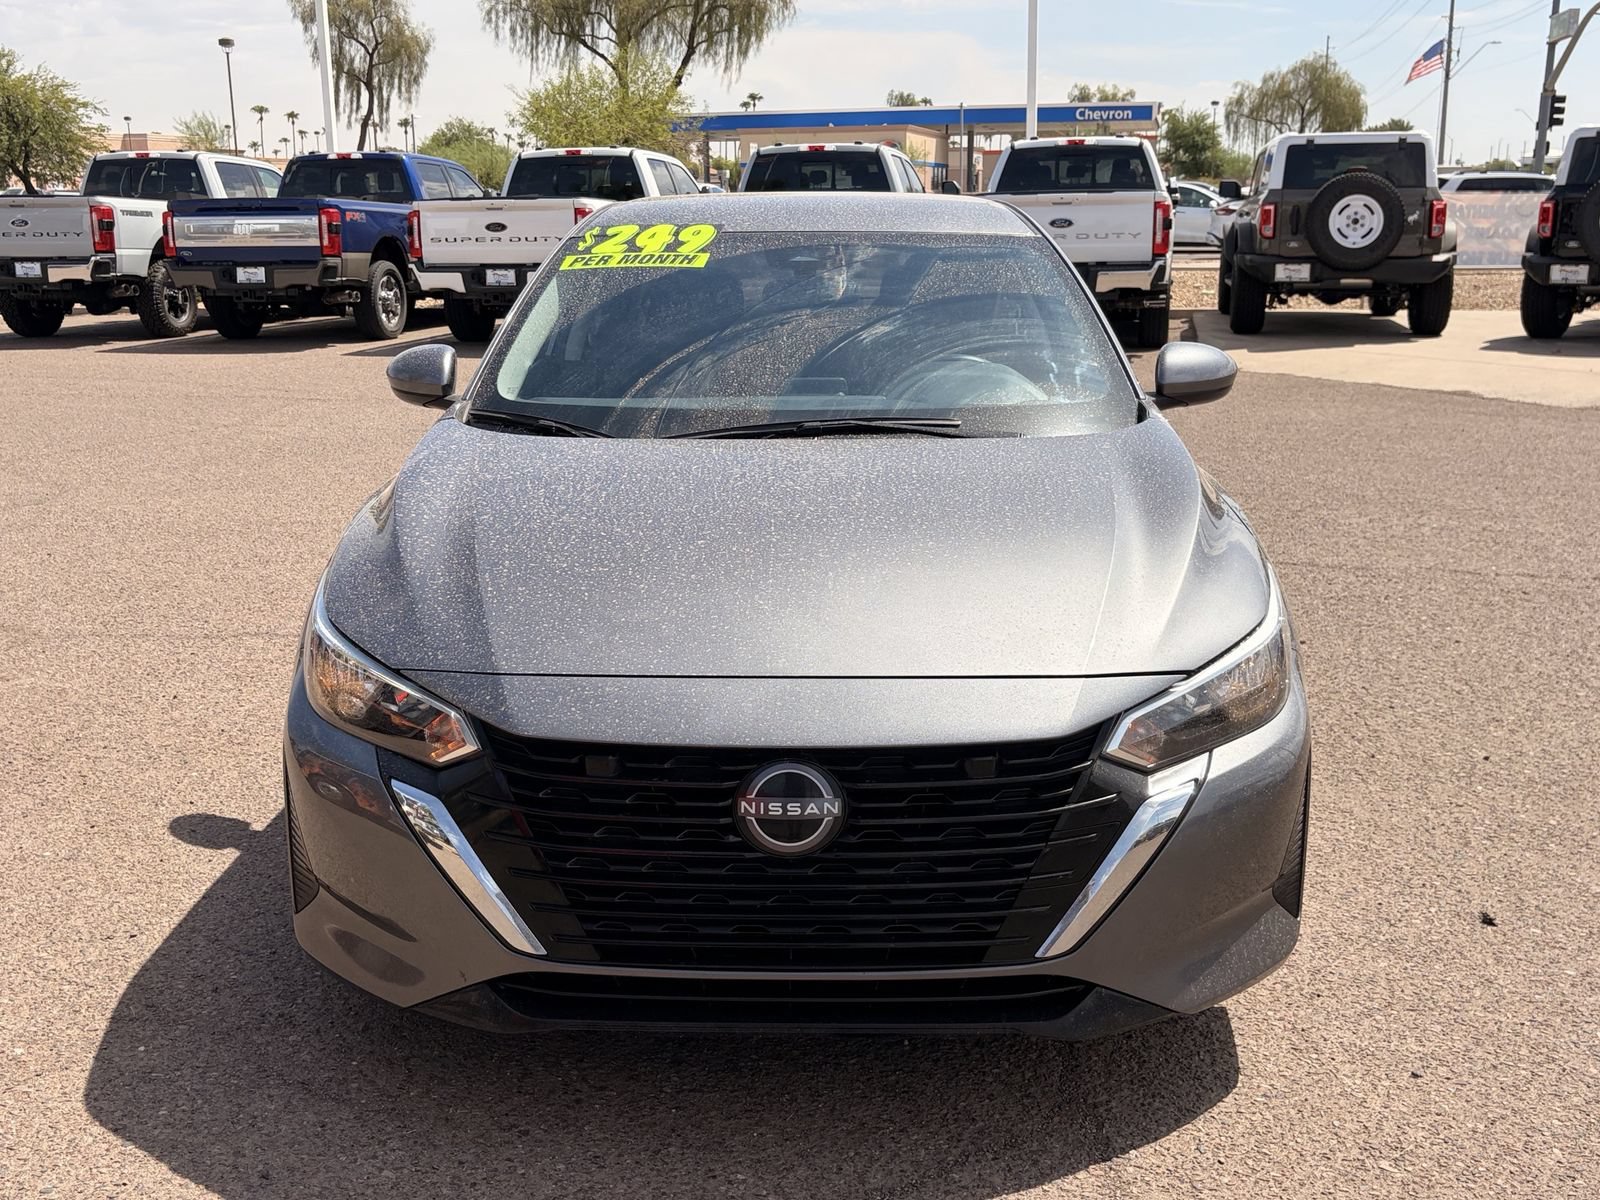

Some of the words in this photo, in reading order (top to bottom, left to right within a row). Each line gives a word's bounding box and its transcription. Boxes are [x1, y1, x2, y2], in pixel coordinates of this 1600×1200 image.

[1075, 108, 1133, 121] Chevron
[577, 223, 718, 254] $249
[1075, 232, 1142, 240] DUTY
[568, 254, 613, 268] PER
[616, 253, 700, 266] MONTH
[740, 800, 839, 816] NISSAN
